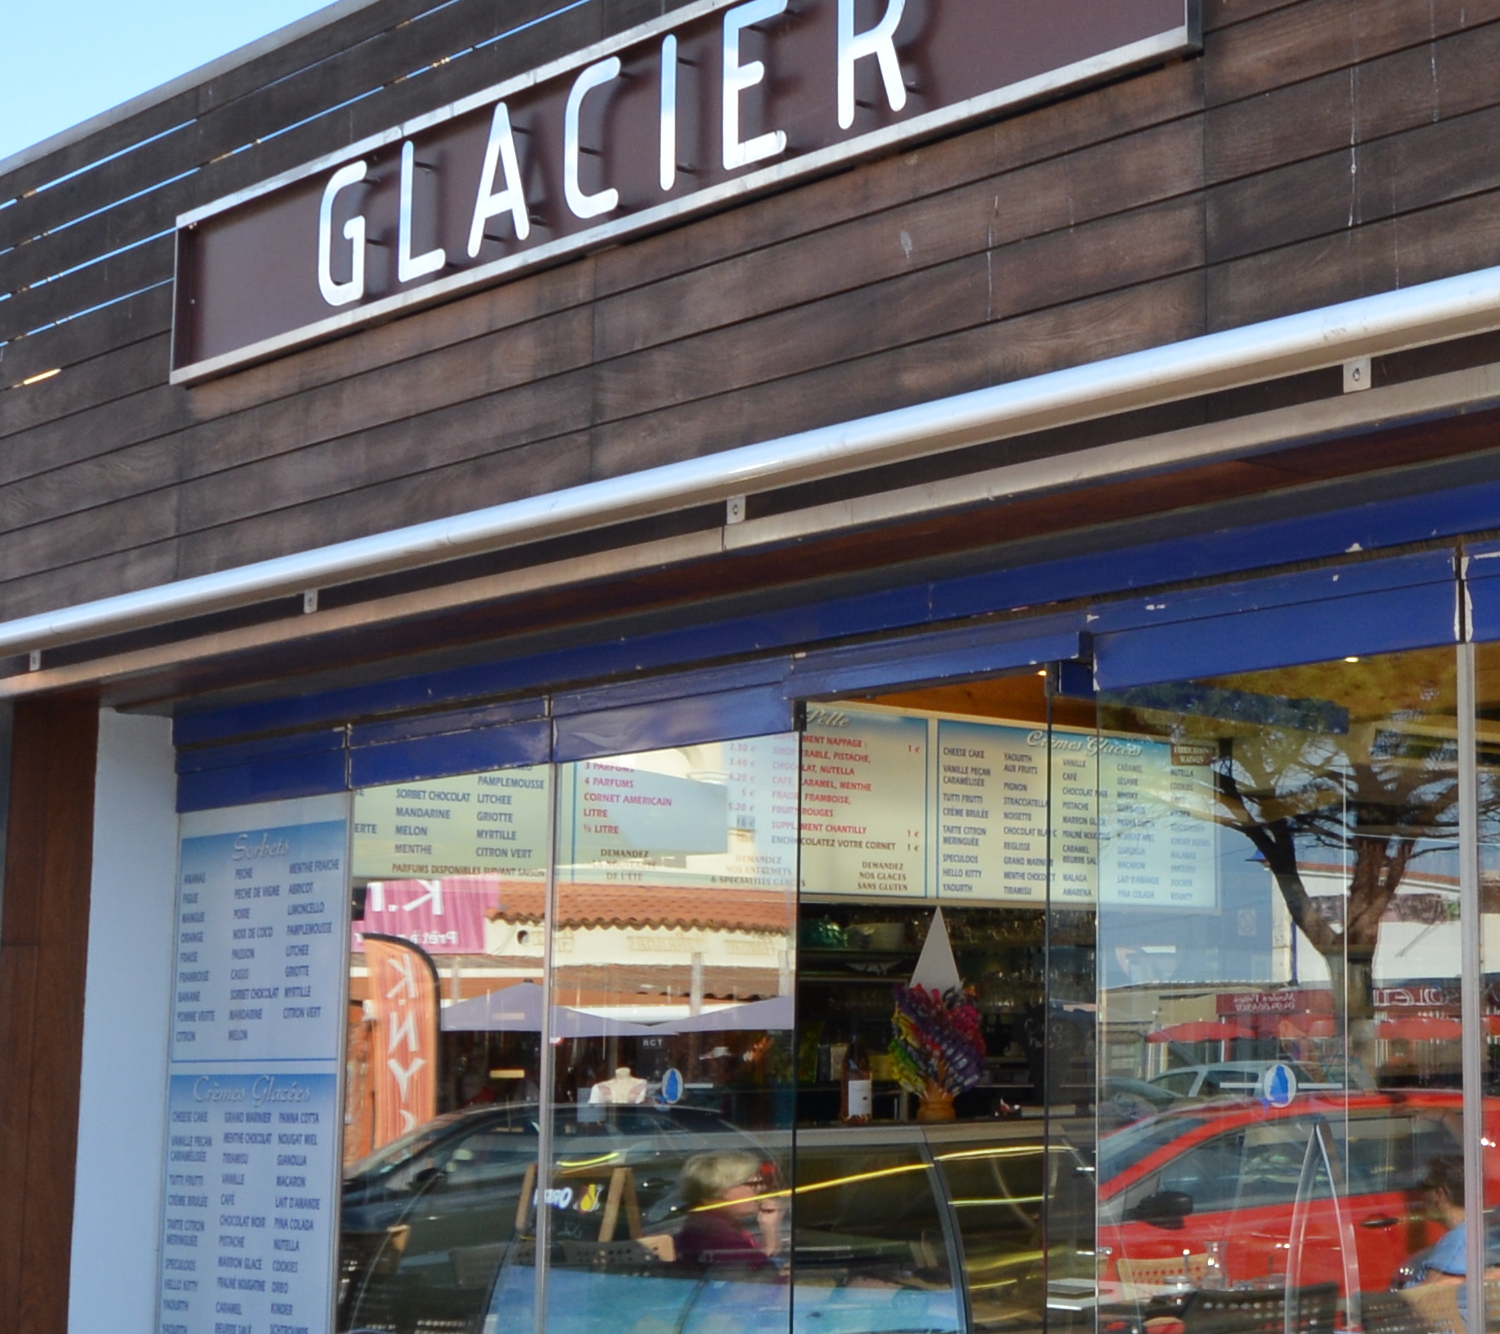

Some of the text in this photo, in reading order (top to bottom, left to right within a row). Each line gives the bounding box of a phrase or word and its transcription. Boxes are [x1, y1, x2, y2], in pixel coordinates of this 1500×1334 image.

[827, 737, 862, 747] NAPPAGE
[943, 747, 985, 759] CHEESE CAKE
[820, 765, 854, 775] NUTELLA
[943, 765, 991, 776] VANILLE PECAN
[1004, 764, 1038, 774] AUX FRUITS
[478, 776, 544, 789] PAMPLEMOUSSE
[585, 777, 634, 788] 4 PARFUMS
[840, 782, 871, 791] MENTHE
[1004, 782, 1027, 792] PIGNON
[397, 789, 471, 802] SORBET CHOCOLAT
[1063, 788, 1092, 797] CHOCOLAT
[477, 794, 512, 805] LITCHEE
[584, 793, 672, 806] CORNET AMERICAIN
[805, 794, 851, 805] FRAMBOISE,
[943, 794, 983, 804] TUTTI FRUTTI
[1063, 801, 1089, 811] PISTACHE
[396, 807, 450, 818] MANDARINE
[477, 812, 513, 823] GRIOTTE
[584, 809, 608, 818] LITRE
[803, 808, 833, 817] ROUGES
[1004, 812, 1032, 821] NOISETTE
[355, 823, 377, 834] ERTE
[395, 825, 428, 836] MELON
[595, 825, 619, 834] LITRE
[826, 825, 866, 834] CHANTILLY
[943, 825, 986, 836] TARTE CITRON
[1004, 827, 1036, 836] CHOCOLAT
[477, 829, 516, 840] MYRTILLE
[232, 833, 290, 861] Sorbets
[395, 844, 432, 855] MENTHE
[838, 840, 895, 850] VOTRE CORNET
[476, 847, 532, 858] CITRON VERT
[601, 849, 649, 858] DEMANDEZ
[943, 854, 978, 864] SPECULOOS
[1004, 857, 1025, 866] GRAND
[392, 863, 428, 874] PARFUMS
[431, 865, 481, 875] DISPONIBLES
[862, 861, 903, 870] DEMANDEZ
[606, 872, 617, 880] DE
[877, 873, 906, 881] GLACES
[943, 869, 982, 879] HELLO KITTY
[1004, 871, 1025, 881] MENTHE
[1063, 873, 1087, 882] MALAGA
[253, 885, 280, 898] DE VIGNE
[288, 882, 313, 894] ABRICOT
[943, 884, 972, 893] YAOURTH
[1004, 885, 1032, 895] TIRAMISU
[287, 902, 324, 915] LIMONCELLO
[248, 928, 255, 939] DE
[257, 926, 273, 938] COCO
[287, 922, 332, 936] PAMPLEMOUSSE
[251, 987, 279, 999] CHOCOLAT
[284, 986, 311, 997] MYRTILLE
[306, 1007, 321, 1018] VERT
[193, 1075, 310, 1107] Crèmes Glacées
[300, 1112, 319, 1123] COTTA
[274, 1239, 299, 1251] NUTELLA
